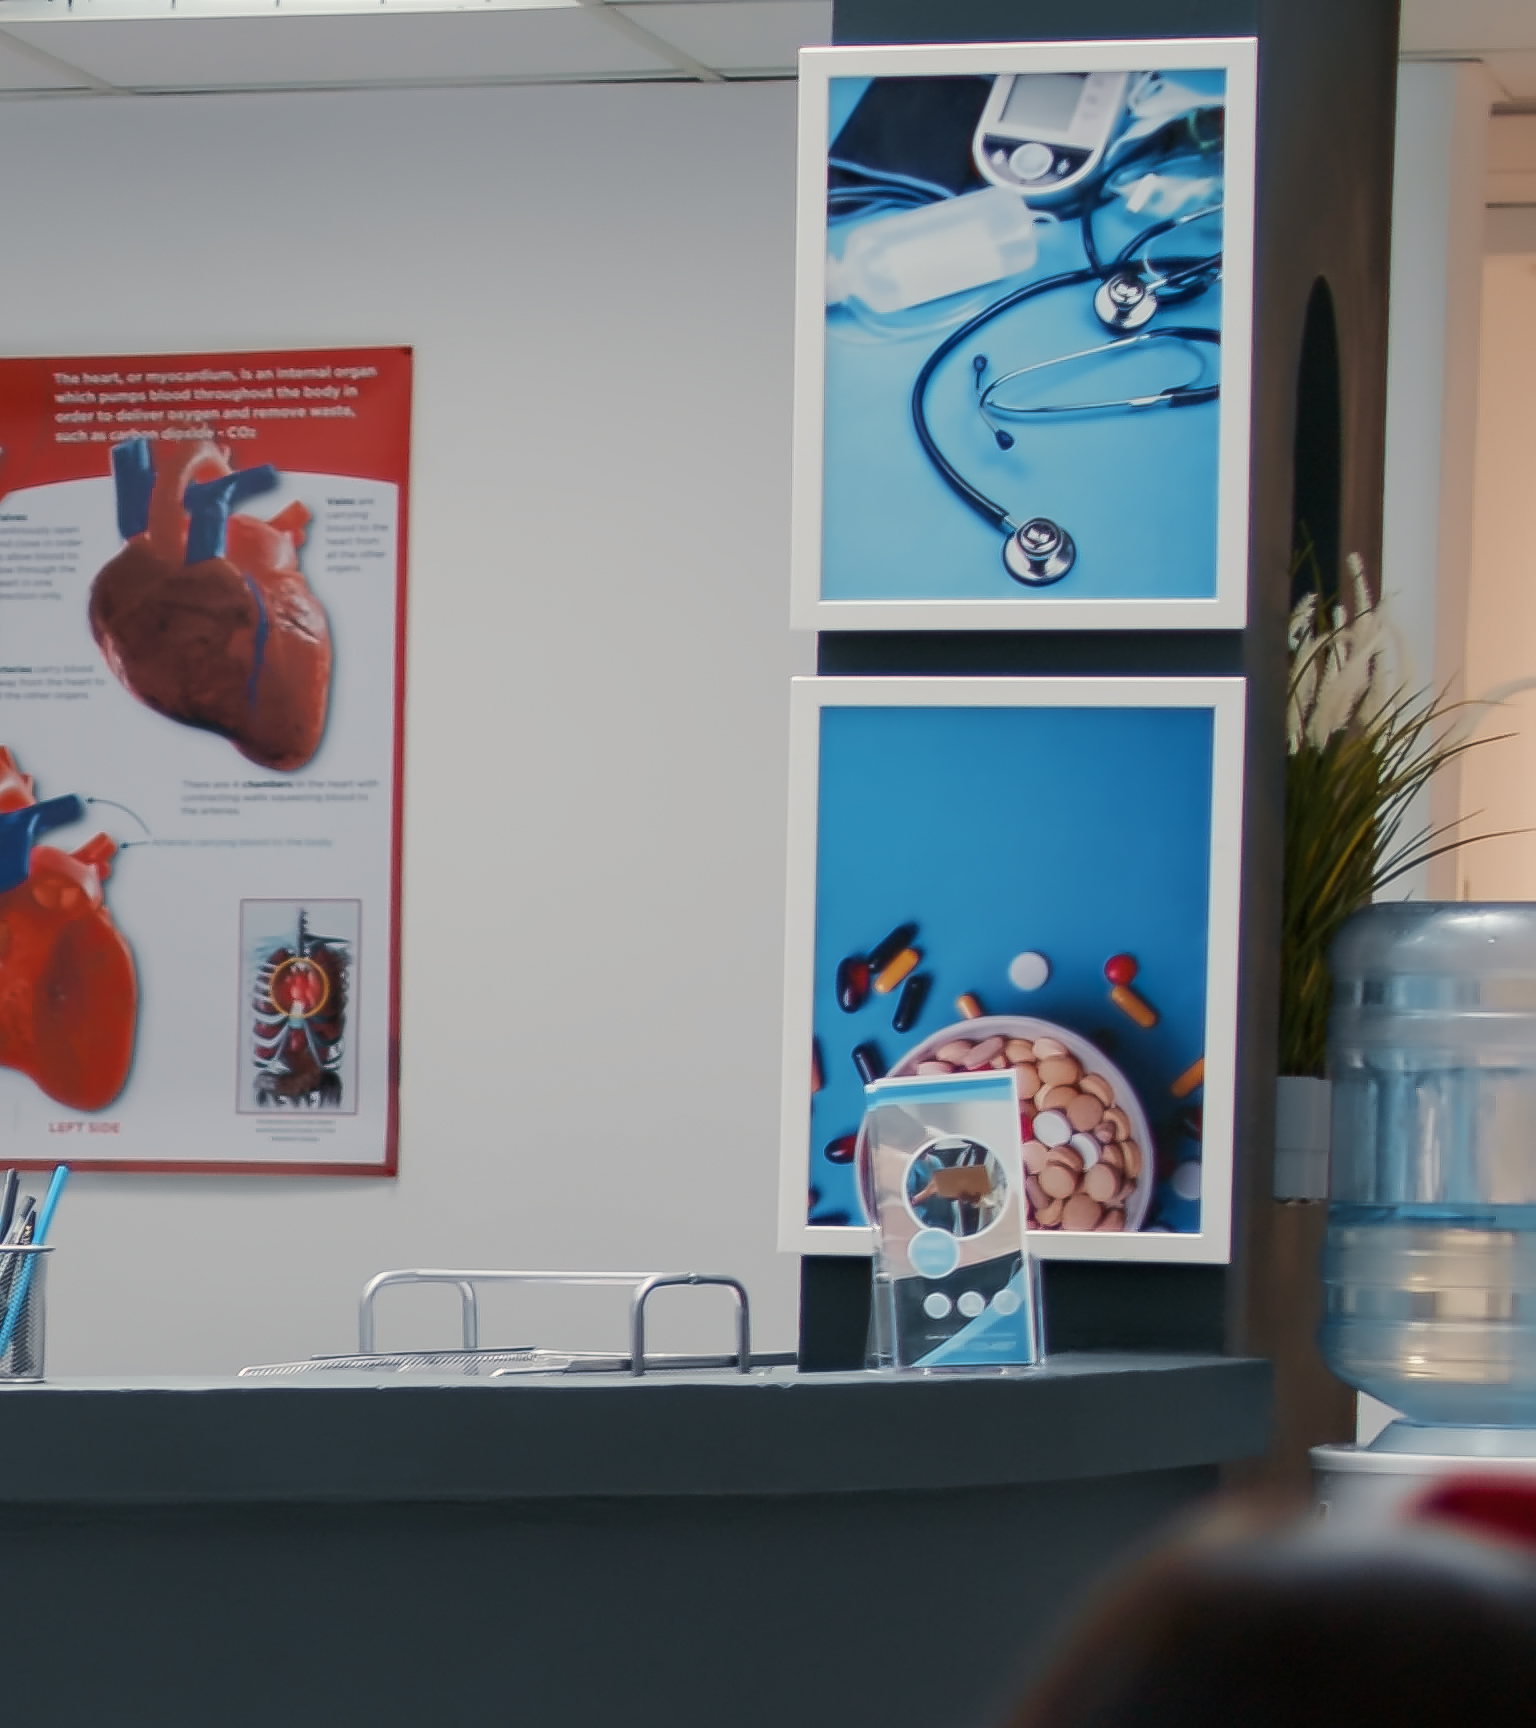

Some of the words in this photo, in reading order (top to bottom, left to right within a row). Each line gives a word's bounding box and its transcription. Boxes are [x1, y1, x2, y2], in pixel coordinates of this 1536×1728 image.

[53, 372, 79, 384] The
[82, 372, 124, 384] heart,
[126, 373, 142, 383] or
[240, 368, 253, 380] is
[256, 369, 274, 380] an
[276, 366, 331, 380] internal
[333, 366, 377, 380] organ
[54, 390, 96, 403] which
[98, 392, 146, 405] pumps
[149, 388, 191, 401] blood
[193, 387, 274, 402] throughout
[276, 386, 300, 398] the
[303, 385, 340, 400] body
[344, 384, 358, 397] in
[55, 410, 93, 423] order
[97, 411, 113, 422] to
[116, 408, 164, 422] deliver
[222, 406, 249, 419] and
[253, 407, 307, 419] remove
[55, 430, 88, 442] such
[91, 432, 106, 441] as
[48, 1122, 84, 1134] LEFT
[88, 1122, 121, 1134] SIDE
